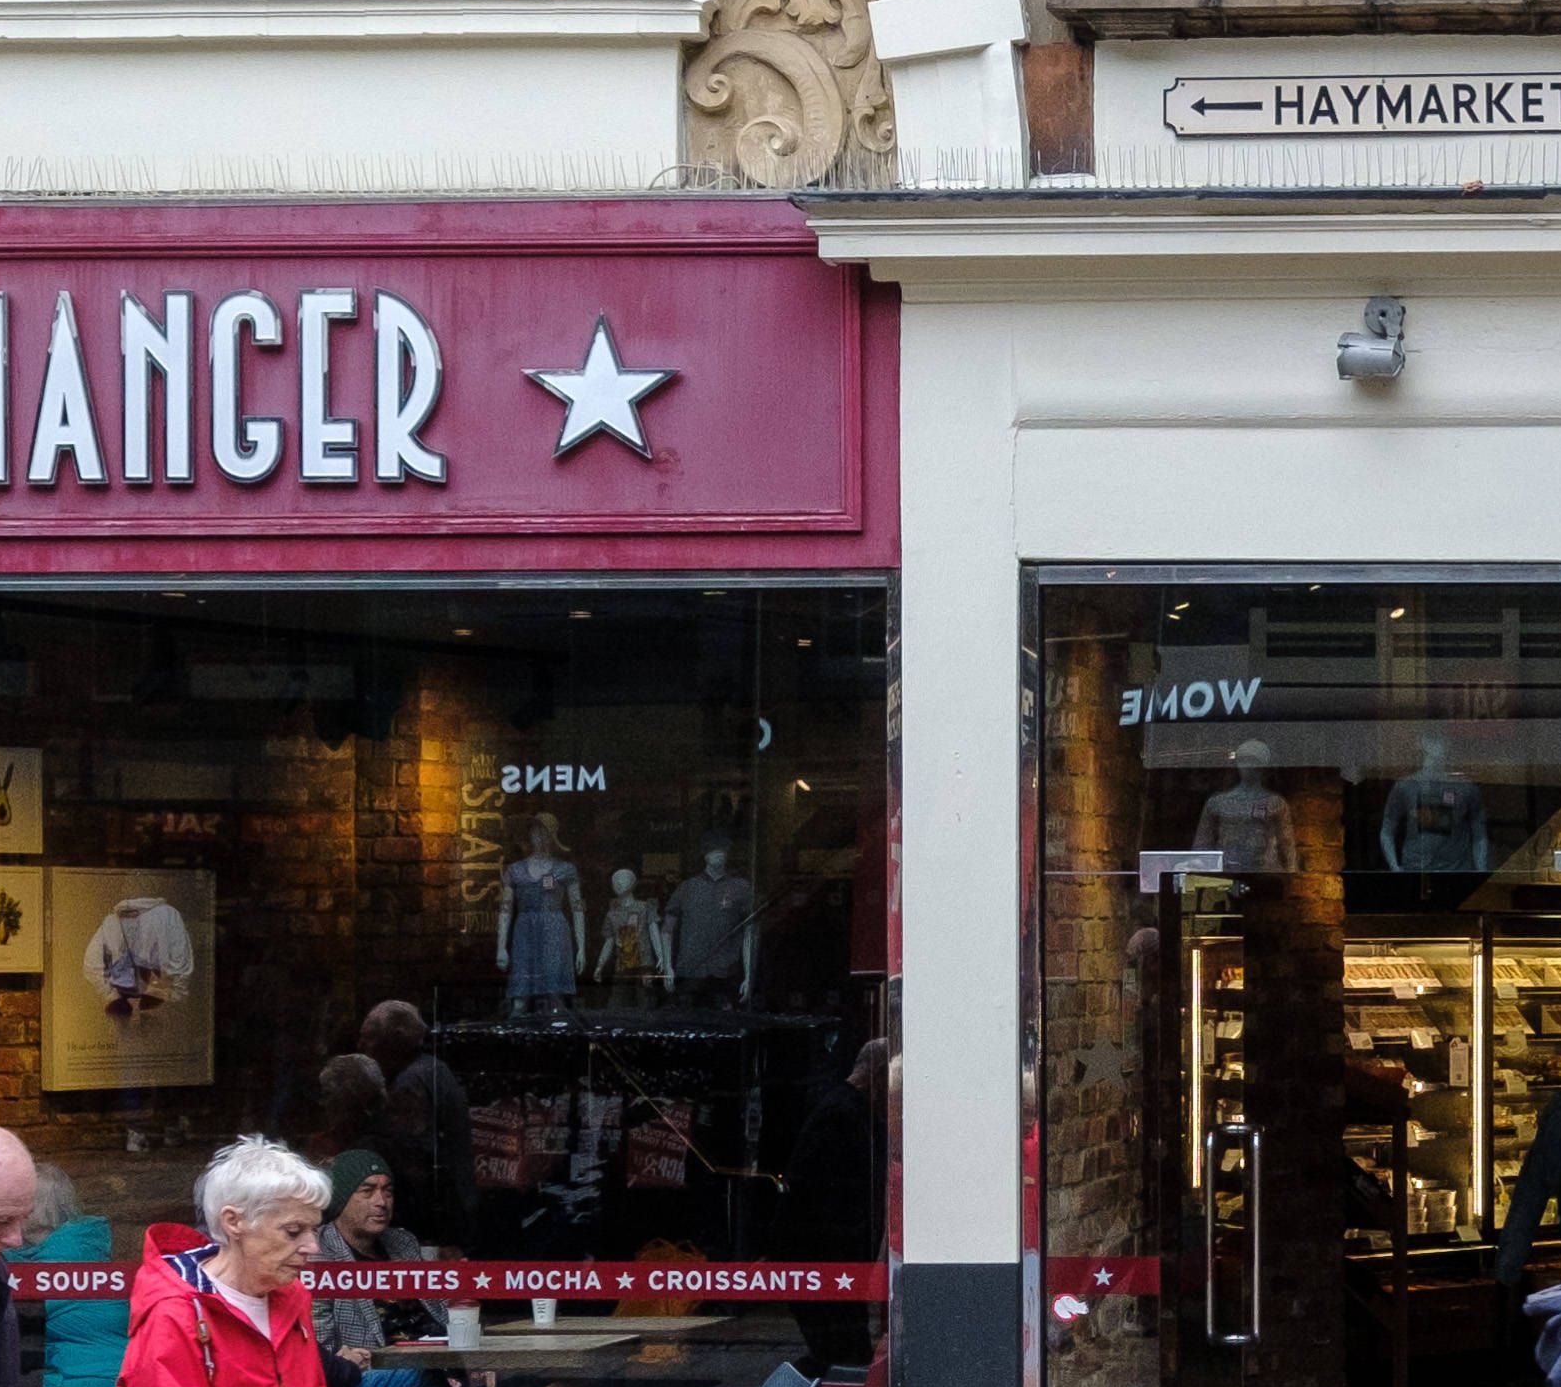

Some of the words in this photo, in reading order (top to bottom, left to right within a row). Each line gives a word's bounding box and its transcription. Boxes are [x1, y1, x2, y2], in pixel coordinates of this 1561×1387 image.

[35, 1271, 125, 1292] SOUPS
[300, 1270, 460, 1290] BAGUETTES
[505, 1270, 602, 1290] MOCHA
[648, 1270, 822, 1291] CROISSANTS
